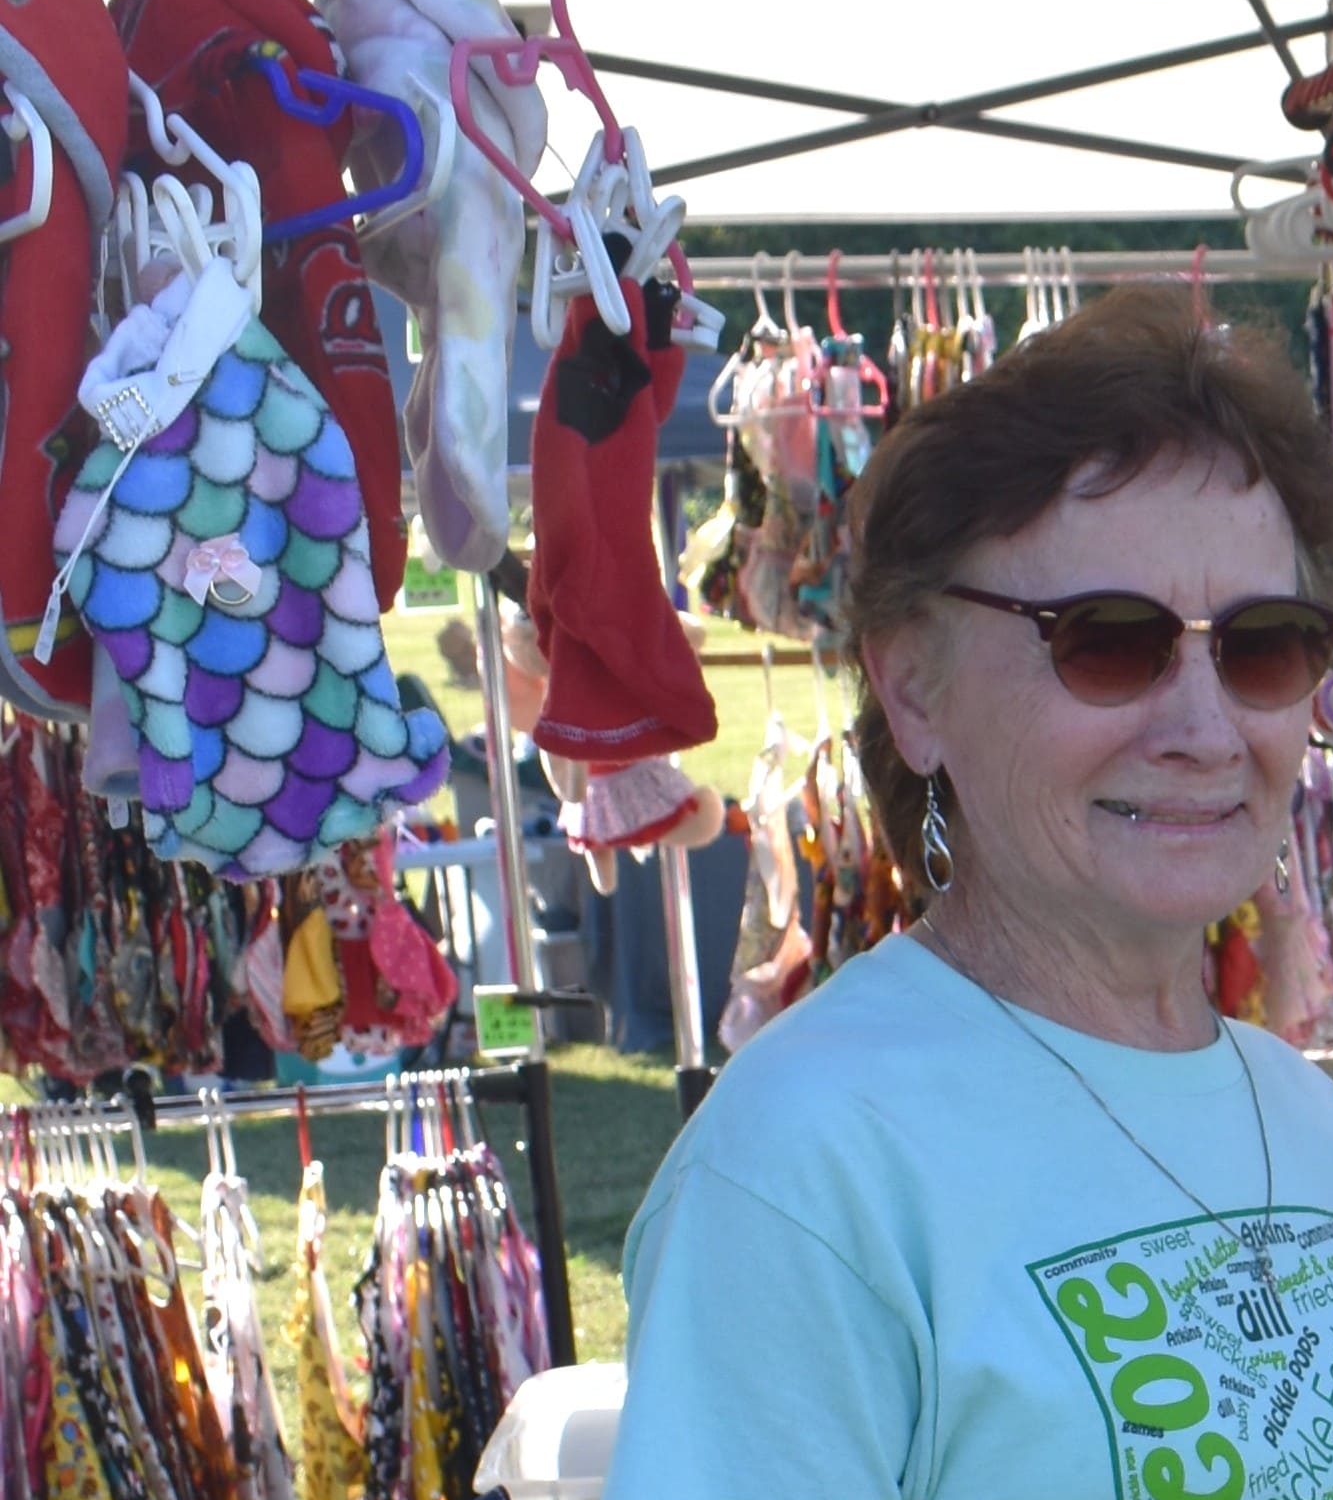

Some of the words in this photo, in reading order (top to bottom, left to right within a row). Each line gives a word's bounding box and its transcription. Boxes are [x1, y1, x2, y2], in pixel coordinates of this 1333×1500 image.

[1044, 1246, 1118, 1280] community
[1140, 1228, 1195, 1258] sweet
[1237, 1287, 1295, 1342] dill
[1263, 1378, 1299, 1449] pickle
[1289, 1326, 1321, 1383] pops
[1249, 1451, 1290, 1499] fried
